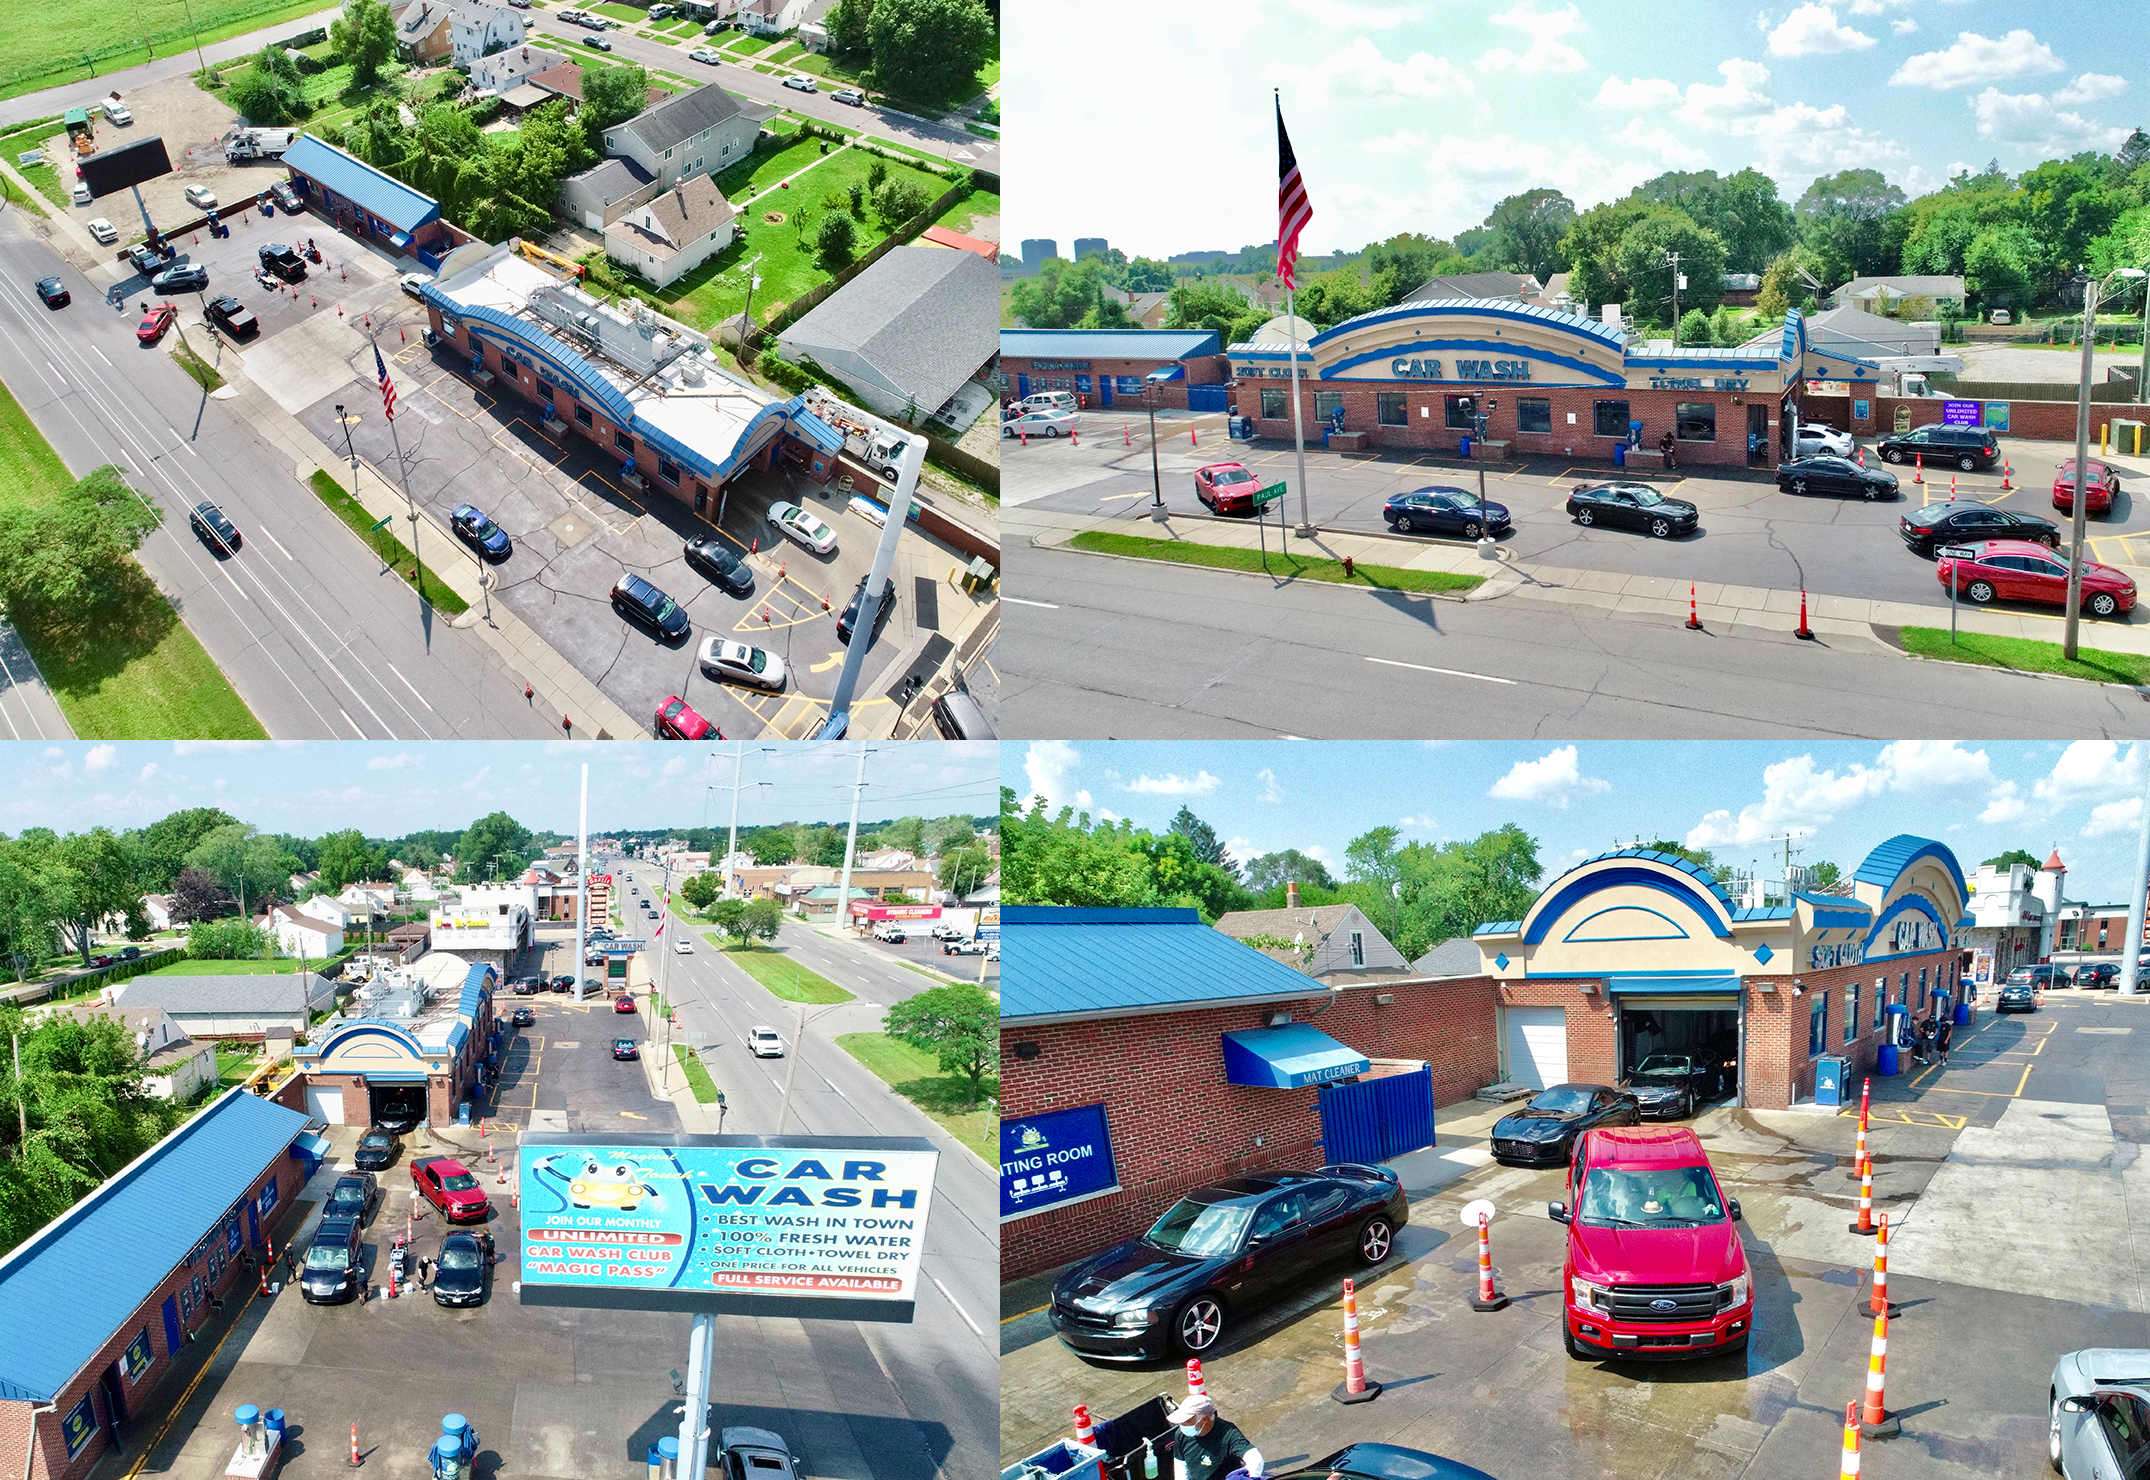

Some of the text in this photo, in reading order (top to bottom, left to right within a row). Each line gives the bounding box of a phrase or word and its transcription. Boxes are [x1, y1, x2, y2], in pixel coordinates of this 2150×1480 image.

[506, 346, 534, 371] CAR
[1236, 366, 1308, 379] SOFT CLOH
[1391, 358, 1530, 380] CAR WASH
[1649, 377, 1750, 392] TOWEL DRY
[1256, 485, 1284, 501] PAUL AVE
[603, 943, 643, 951] CAR WASH
[1303, 1063, 1361, 1084] MAT CLEANER
[607, 1151, 677, 1161] Magical
[1046, 1144, 1093, 1166] ROOM
[636, 1168, 694, 1179] Touch
[735, 1157, 888, 1182] CAR
[698, 1184, 918, 1209] WASH
[545, 1215, 662, 1229] JOIN OUR MONTHLY
[718, 1215, 914, 1230] BEST WASH IN TOWN
[543, 1230, 666, 1244] UNLIMITED
[720, 1231, 911, 1247] 100% FRESH WATER
[528, 1246, 673, 1261] CAR WASH CLUB
[713, 1246, 752, 1255] SOFT
[877, 1251, 911, 1261] DRY
[710, 1260, 898, 1274] ONE PRICE FOR ALL VEHICLES
[717, 1273, 899, 1290] FULL SERVICE AVAILABLE
